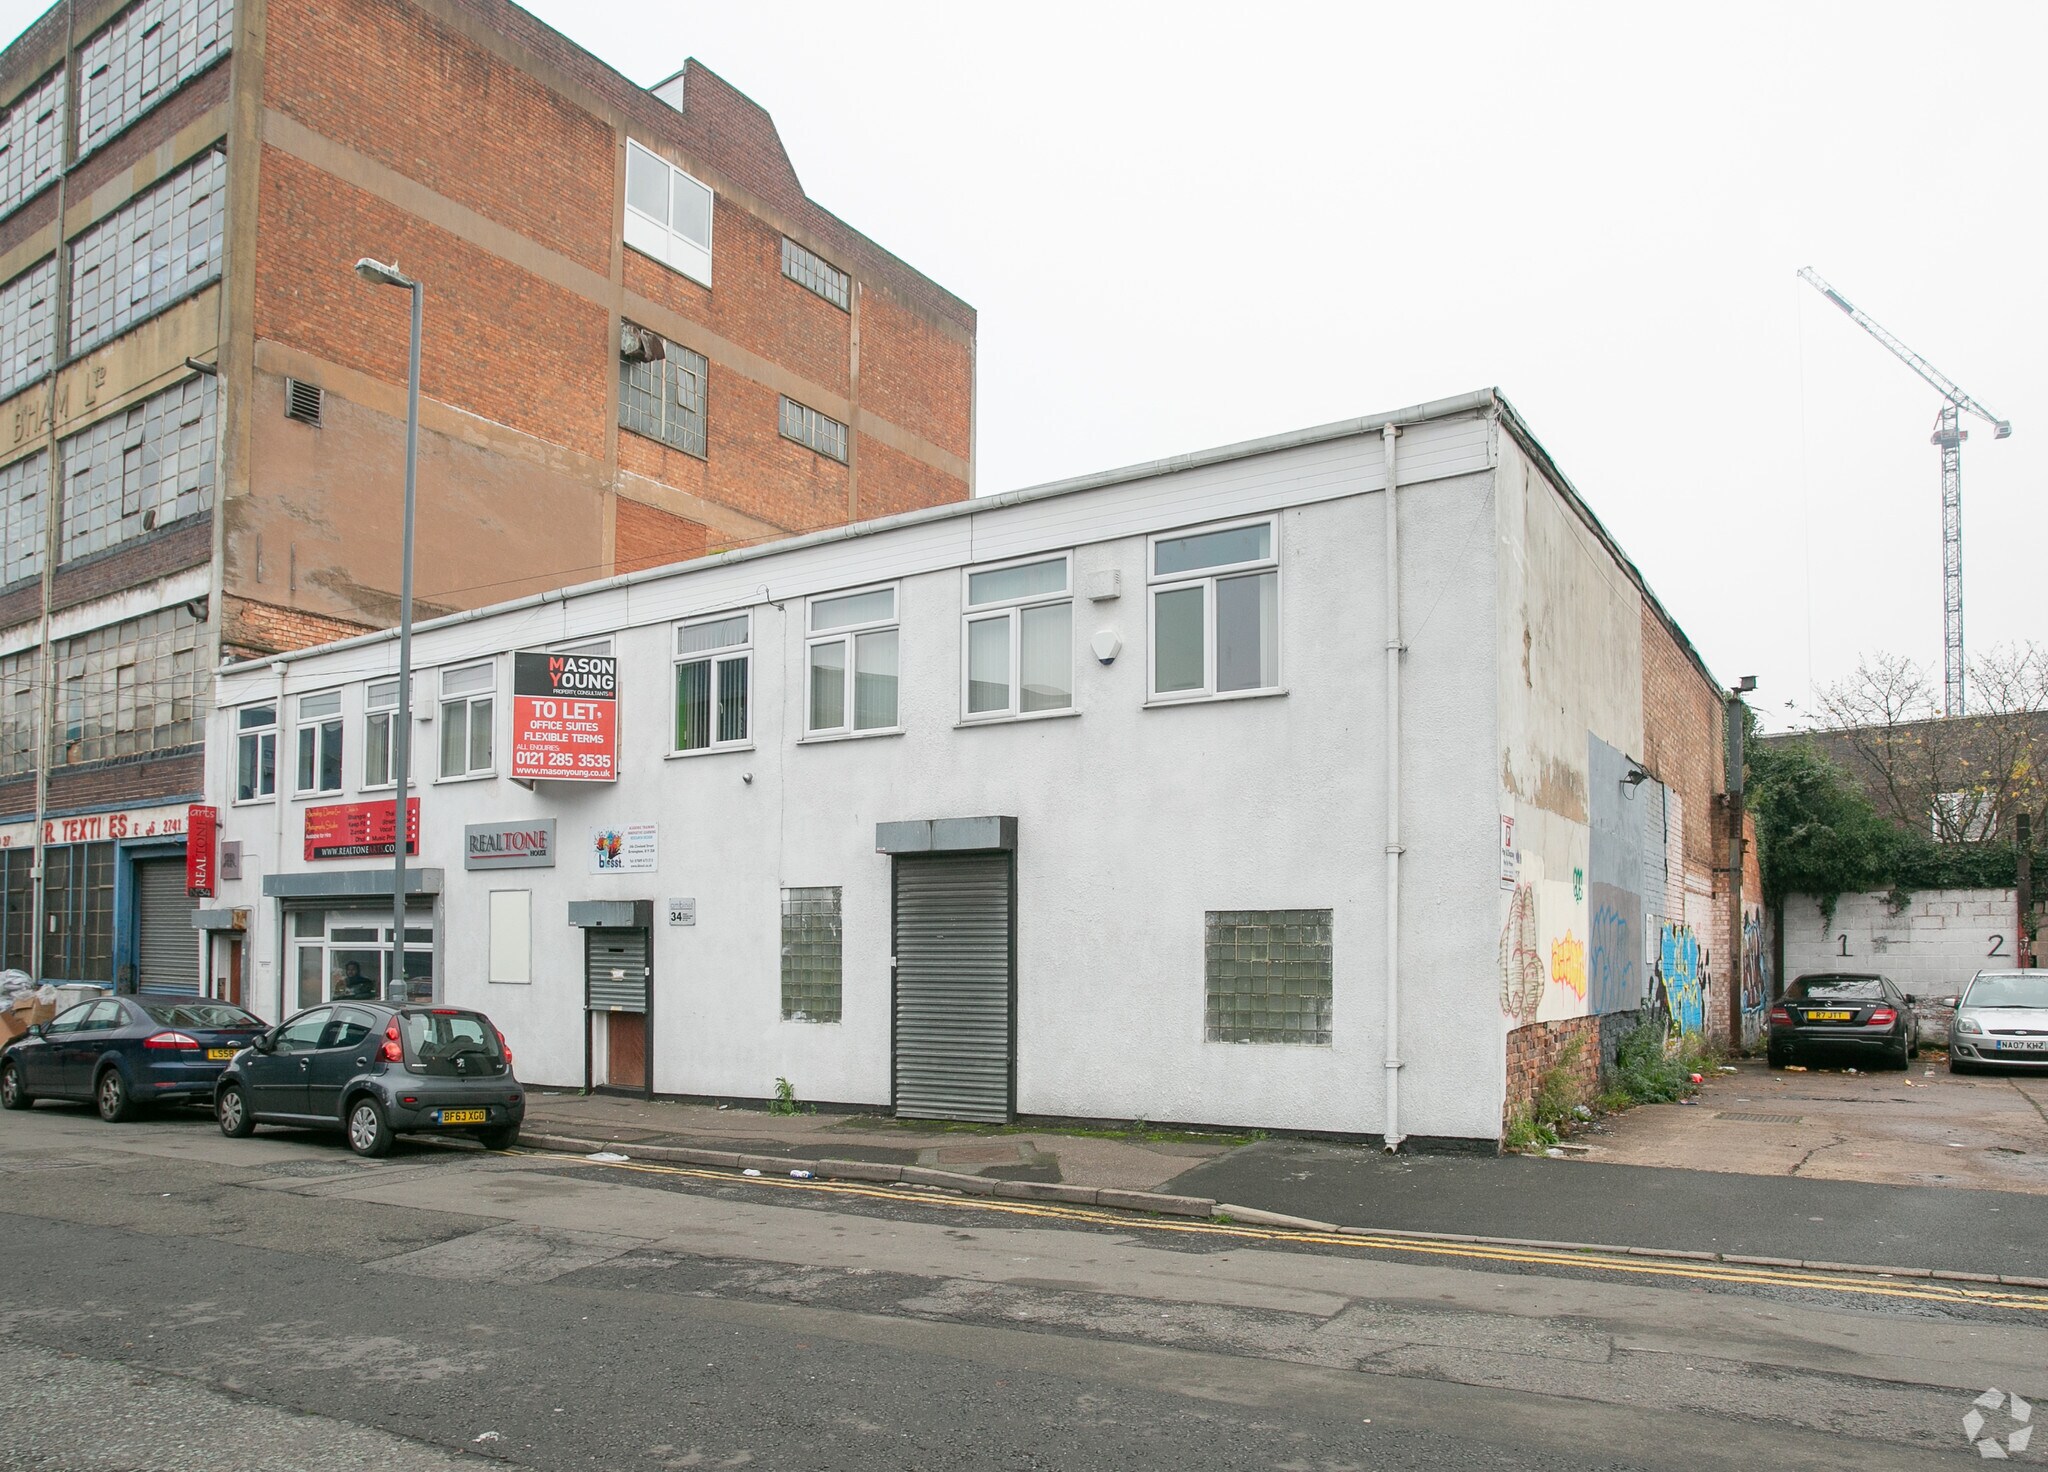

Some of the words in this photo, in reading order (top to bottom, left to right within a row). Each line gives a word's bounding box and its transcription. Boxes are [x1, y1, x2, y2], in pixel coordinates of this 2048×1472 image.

[549, 656, 615, 675] MASON
[549, 672, 614, 690] YOUNG
[552, 688, 576, 697] PROPERTY
[531, 700, 557, 718] TO
[530, 720, 562, 730] OFFICE
[566, 722, 599, 732] SUITES
[524, 731, 568, 742] FLEXIBLE
[572, 733, 604, 744] TERMS
[516, 751, 544, 765] 0121
[548, 752, 573, 767] 285
[578, 754, 611, 768] 3535
[516, 767, 610, 778] www.masonyoung.co.uk
[189, 806, 216, 819] arts
[469, 830, 548, 853] REALTONE
[670, 911, 682, 922] 34
[1836, 934, 1854, 957] 1
[1987, 934, 2011, 957] 2
[1815, 1011, 1826, 1019] R7
[2001, 1041, 2025, 1049] NA07
[2026, 1041, 2045, 1050] KHZ
[444, 1111, 467, 1121] BF63
